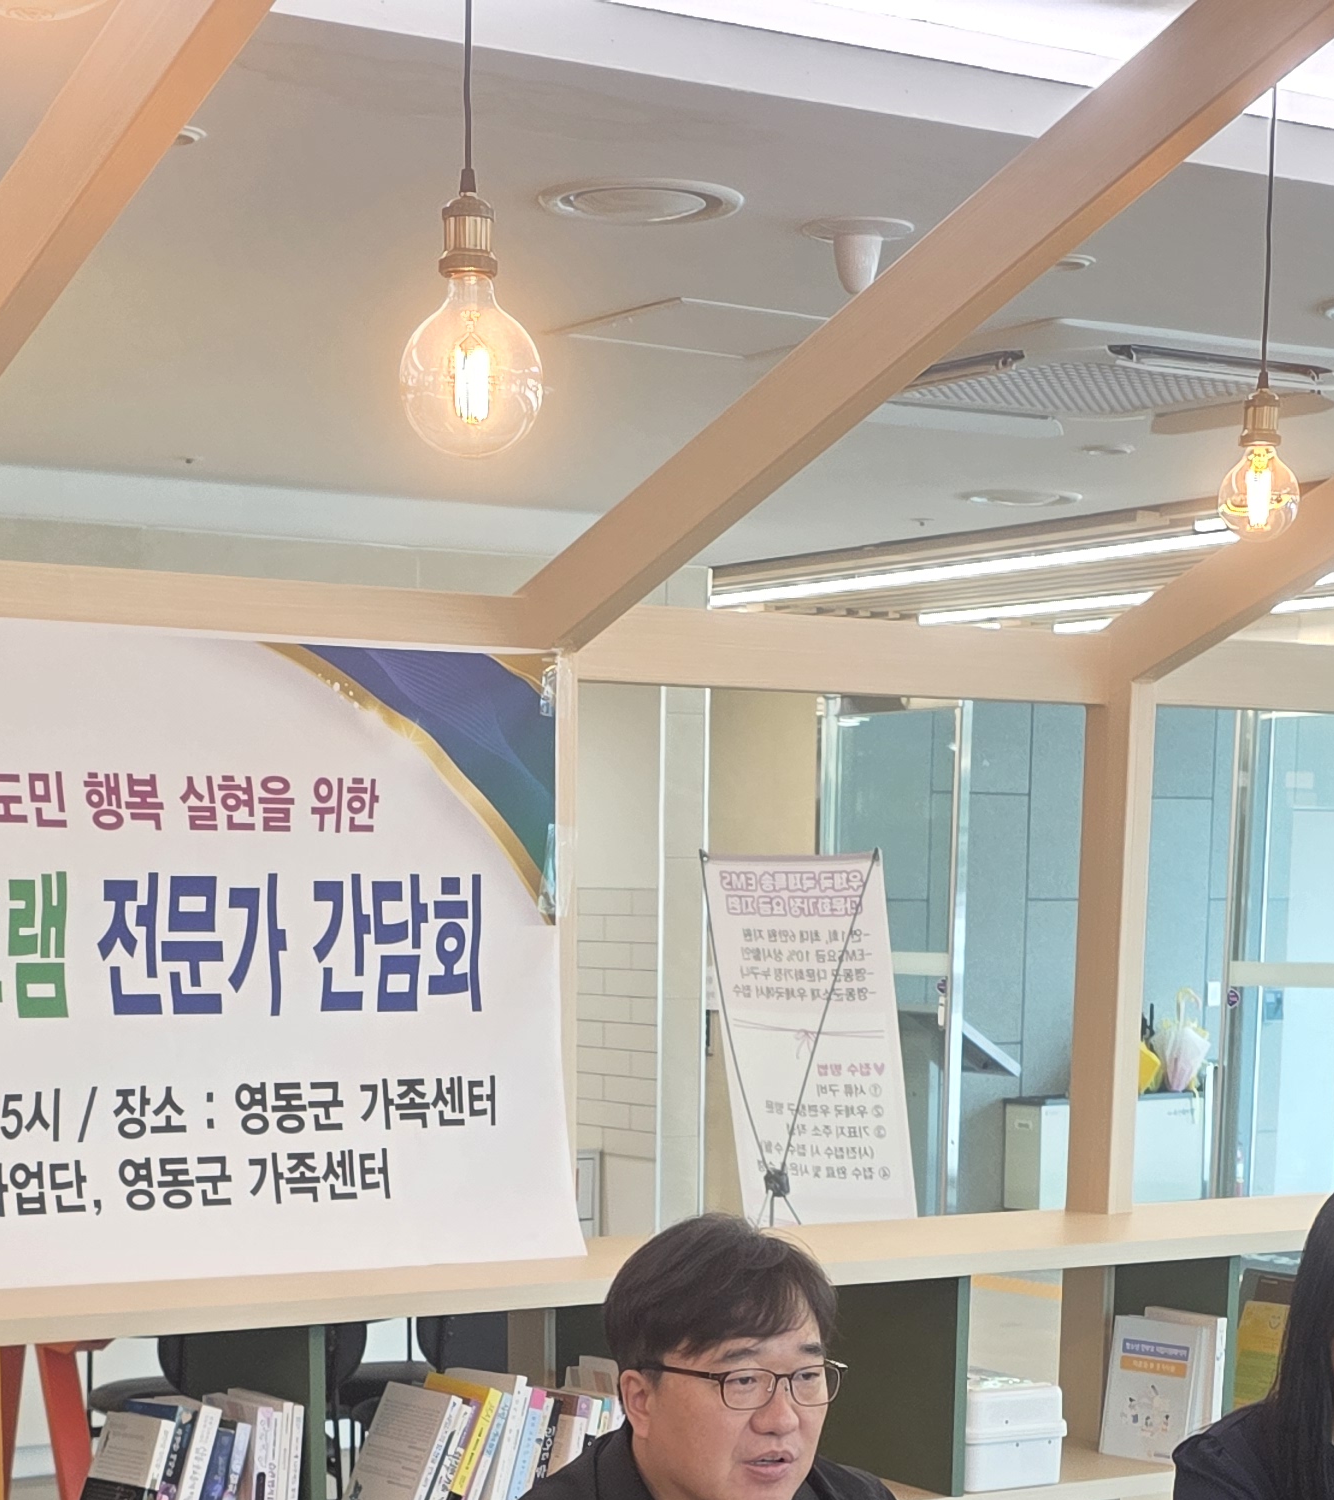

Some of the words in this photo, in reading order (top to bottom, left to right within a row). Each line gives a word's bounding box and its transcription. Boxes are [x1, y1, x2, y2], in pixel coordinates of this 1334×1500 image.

[83, 771, 165, 831] 행복
[179, 774, 295, 833] 실현을
[310, 777, 380, 834] 위한
[96, 871, 288, 1017] 전문가
[312, 873, 483, 1013] 간담회
[77, 1086, 98, 1143] /
[112, 1085, 187, 1140] 장소
[206, 1091, 215, 1130] :
[234, 1081, 344, 1136] 영동군
[359, 1074, 496, 1131] 가족센터
[118, 1155, 233, 1211] 영동군
[248, 1147, 391, 1205] 가족센터
